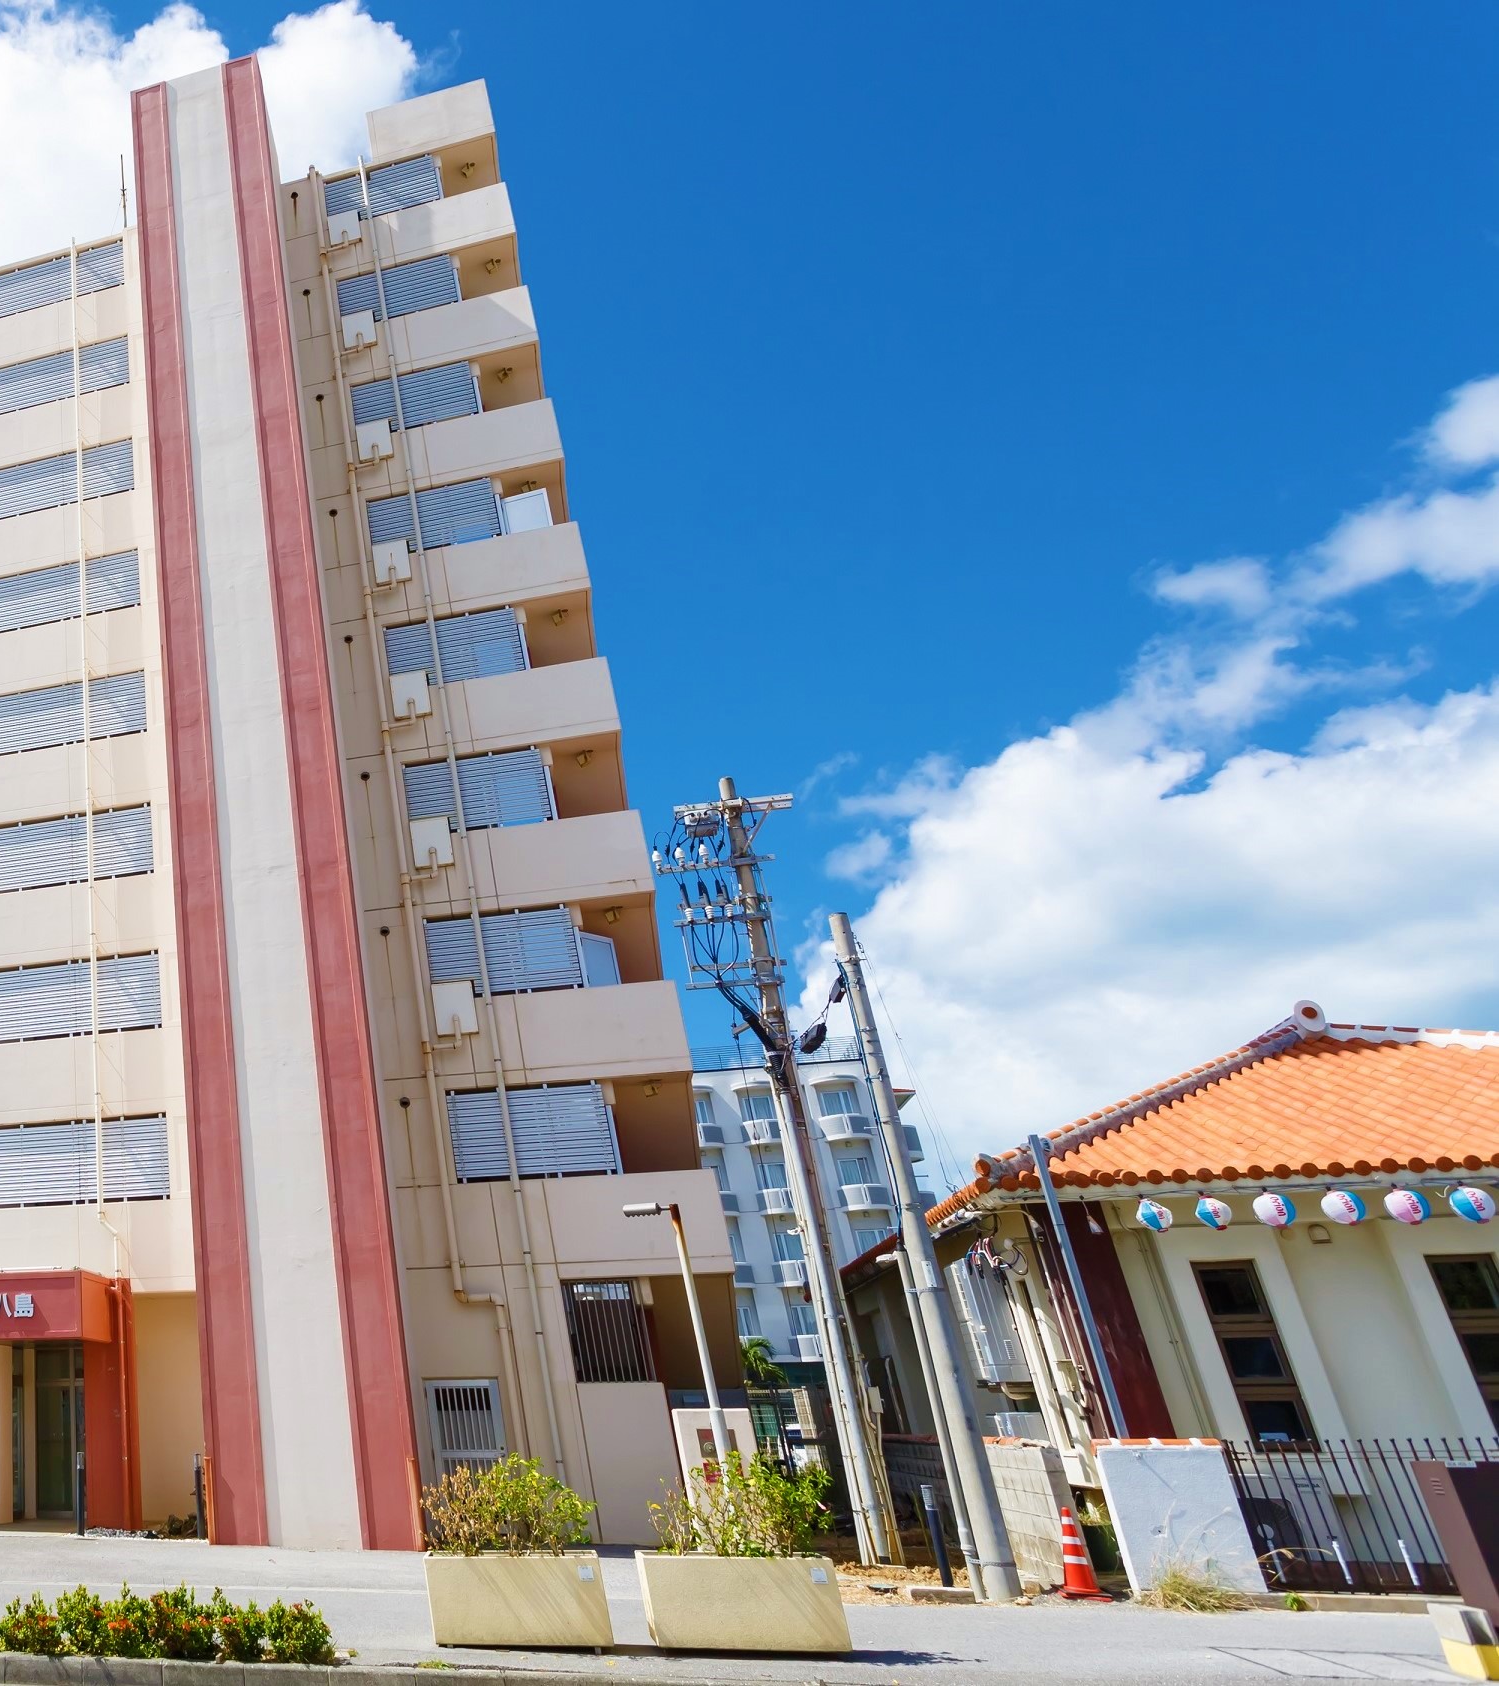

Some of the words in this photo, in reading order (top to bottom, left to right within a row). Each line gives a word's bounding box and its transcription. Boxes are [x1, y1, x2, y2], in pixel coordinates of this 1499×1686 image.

[1270, 1196, 1286, 1217] Orion
[1336, 1193, 1356, 1214] Orion
[1403, 1193, 1422, 1215] Orion
[1466, 1191, 1486, 1212] Orion
